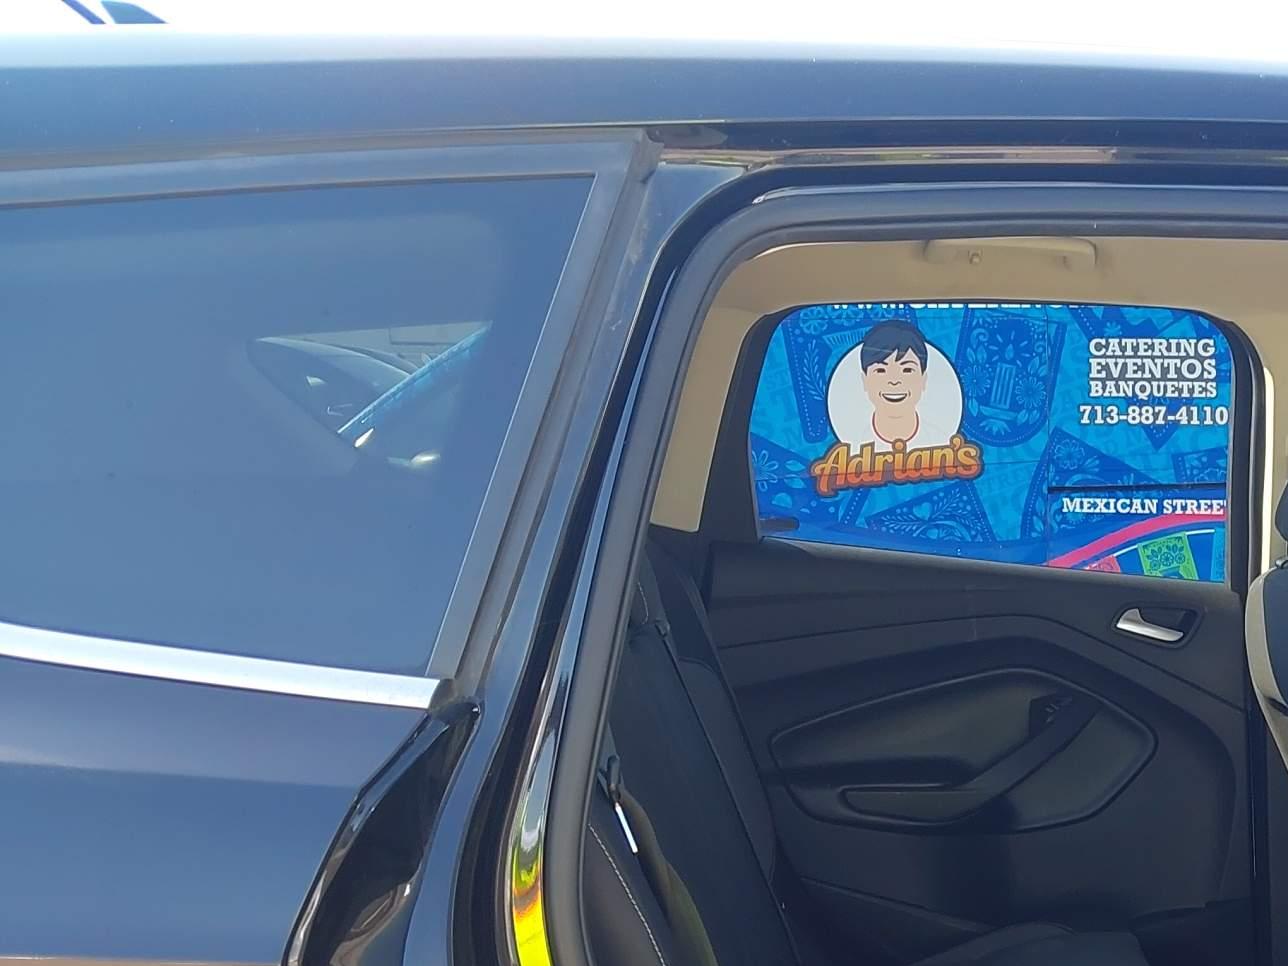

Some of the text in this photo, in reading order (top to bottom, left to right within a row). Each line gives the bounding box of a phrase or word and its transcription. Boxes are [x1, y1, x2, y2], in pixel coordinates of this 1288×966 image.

[1089, 338, 1216, 357] CATERING
[1089, 358, 1217, 379] EVENTOS
[1089, 380, 1217, 400] BANQUETES
[1079, 405, 1229, 425] 713-887-4110
[813, 436, 980, 494] Adrian's
[1062, 497, 1227, 515] MEXICAN STREE
